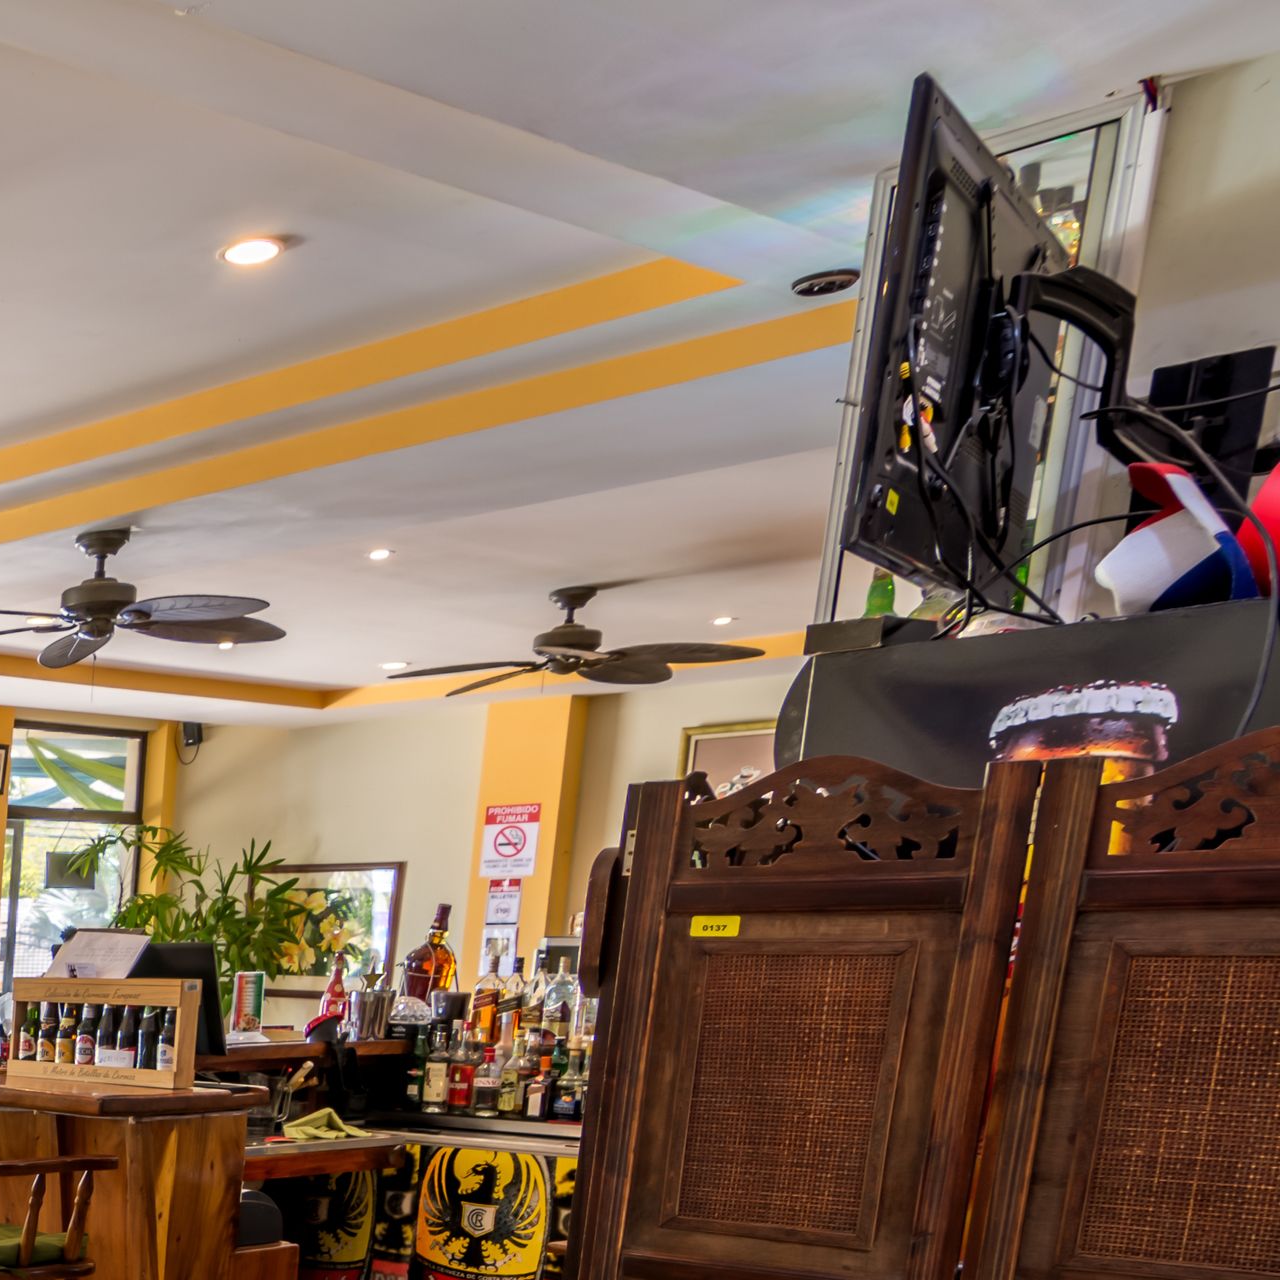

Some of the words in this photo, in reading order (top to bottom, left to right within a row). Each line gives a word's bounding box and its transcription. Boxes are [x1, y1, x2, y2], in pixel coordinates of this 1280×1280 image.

[488, 805, 539, 816] PROHIBIDO
[496, 813, 528, 823] FUMAR
[702, 924, 728, 932] 0137
